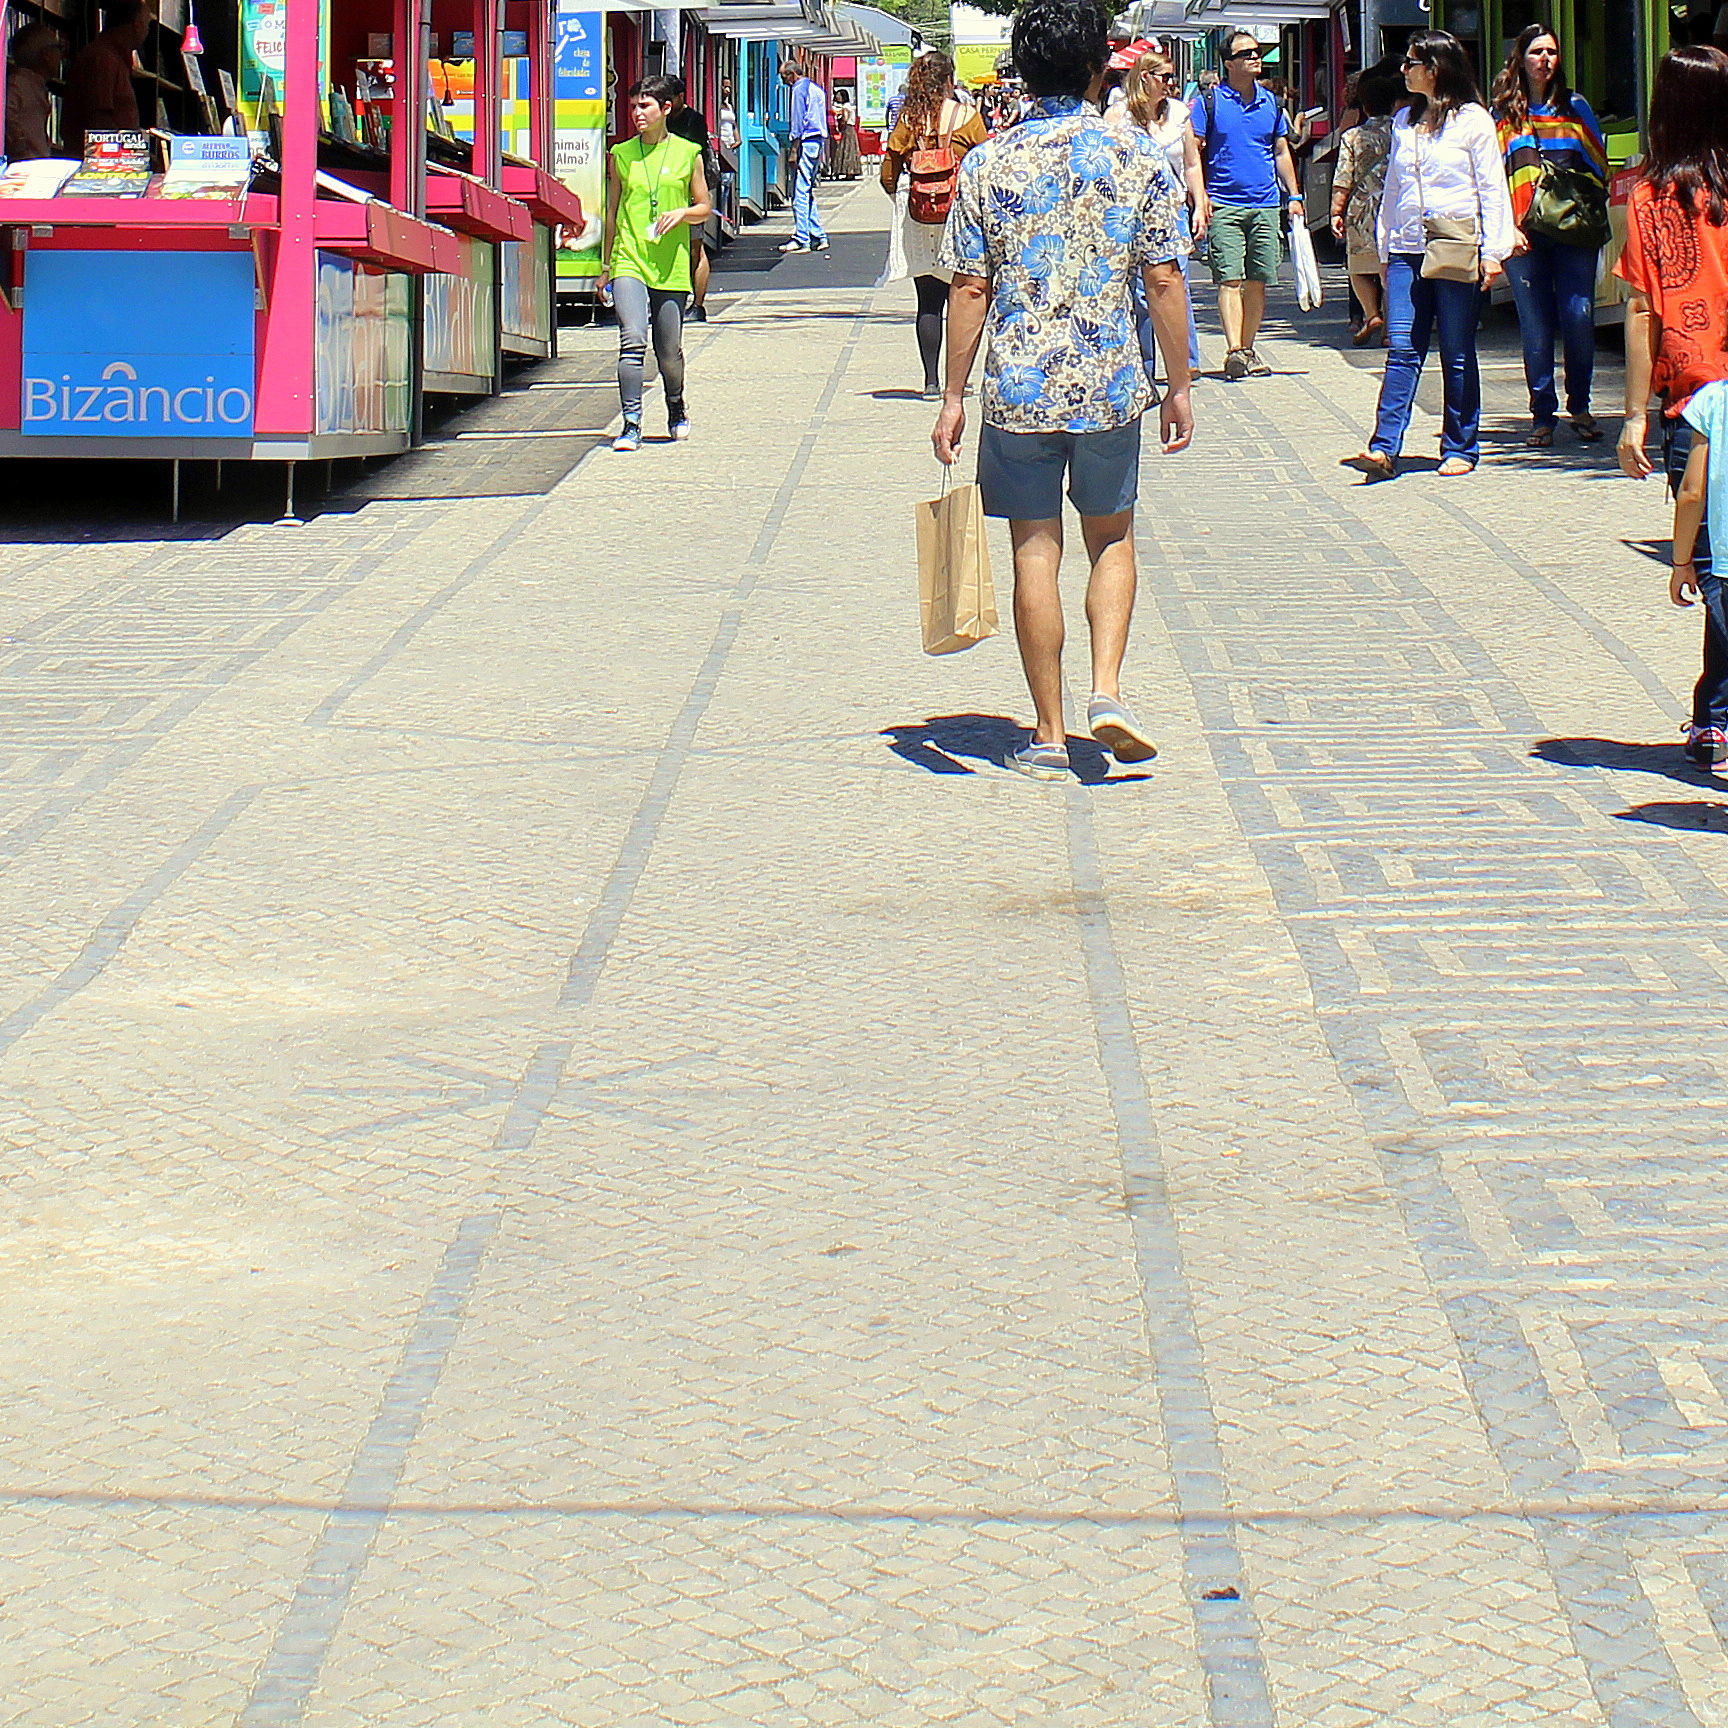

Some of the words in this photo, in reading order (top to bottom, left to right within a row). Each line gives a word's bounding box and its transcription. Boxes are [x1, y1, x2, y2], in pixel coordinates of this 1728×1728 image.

[88, 132, 145, 144] PORTUGAL
[554, 138, 590, 151] nimais
[23, 361, 251, 424] Bizâncio
